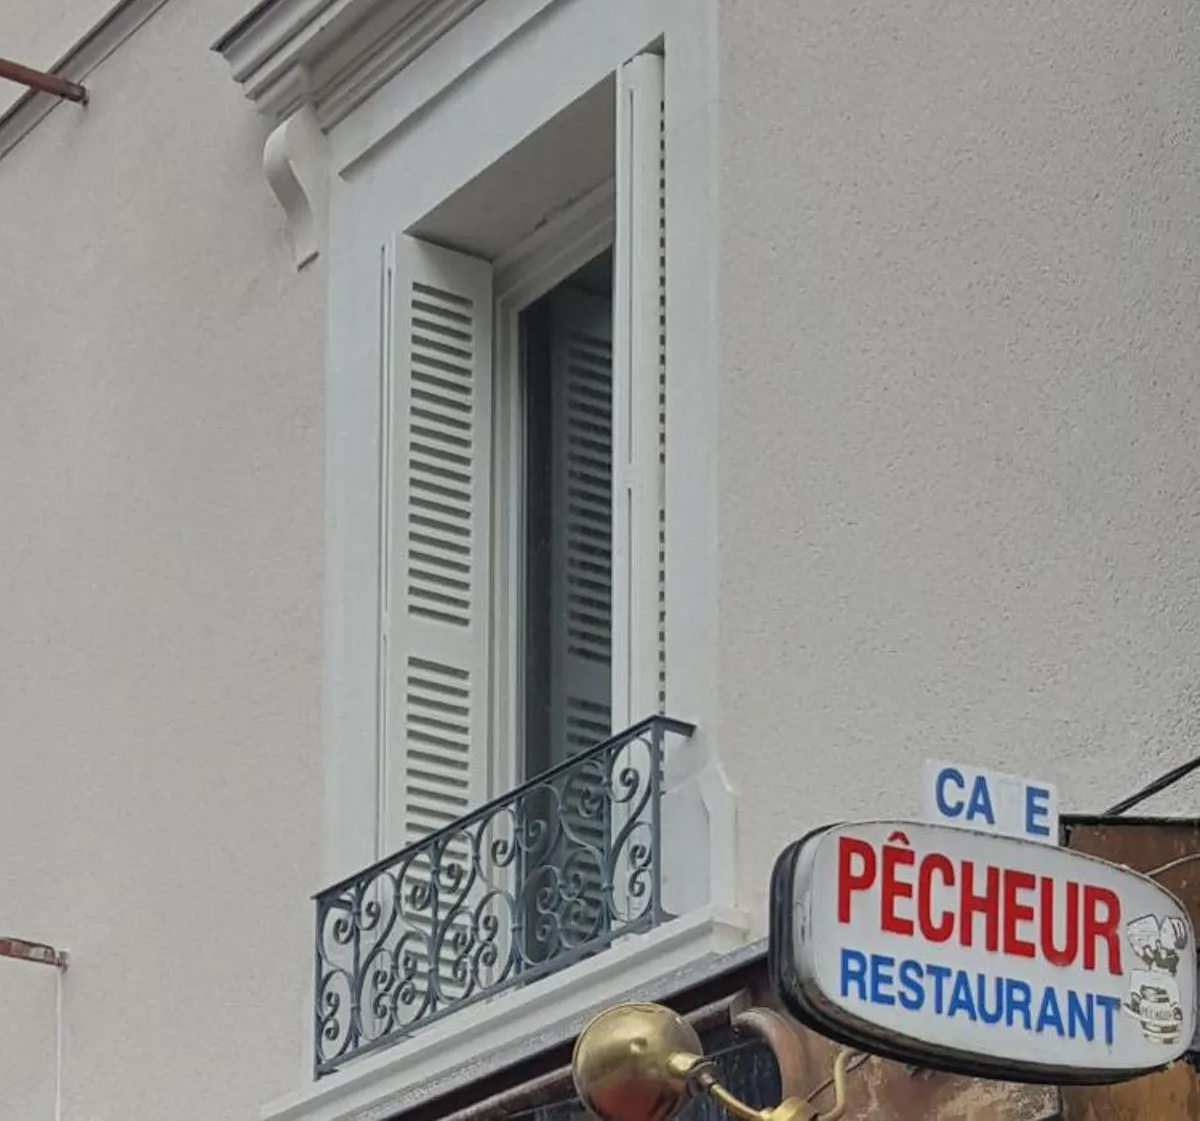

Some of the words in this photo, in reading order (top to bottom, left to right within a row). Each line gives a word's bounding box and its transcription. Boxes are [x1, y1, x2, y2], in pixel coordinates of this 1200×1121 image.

[935, 766, 1050, 836] CAE
[837, 830, 1123, 976] PÊCHEUR
[840, 947, 1121, 1046] RESTAURANT
